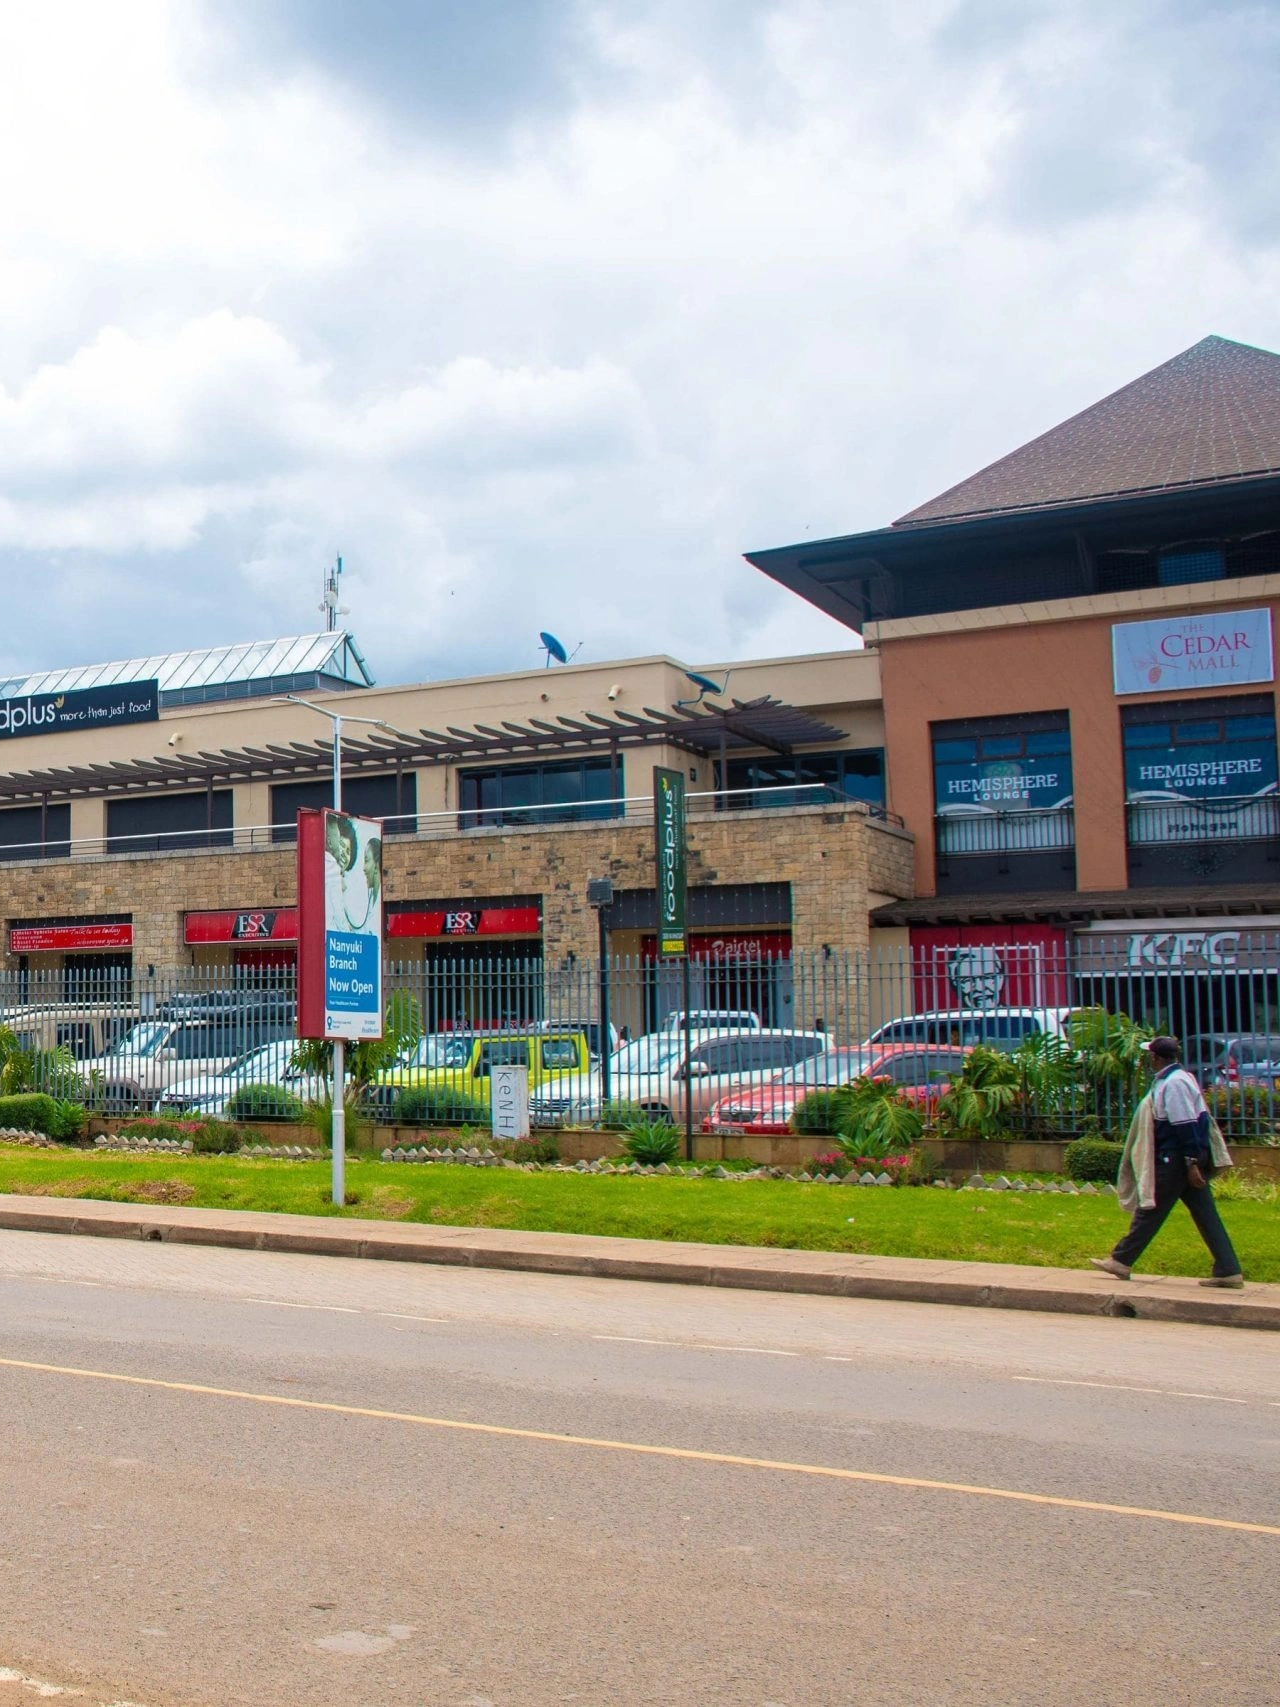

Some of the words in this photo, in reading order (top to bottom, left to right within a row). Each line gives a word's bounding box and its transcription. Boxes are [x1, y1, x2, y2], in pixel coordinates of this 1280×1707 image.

[1181, 624, 1204, 633] THE
[1160, 632, 1251, 657] CEDAR
[1188, 654, 1240, 672] MALL
[60, 711, 87, 721] more
[88, 706, 107, 719] than
[109, 702, 125, 718] just
[129, 700, 152, 713] food
[1139, 758, 1262, 780] HEMISPHERE
[947, 773, 1059, 794] HEMISPHERE
[1165, 776, 1227, 788] LOUNGE
[973, 790, 1030, 802] LOUNGE
[663, 789, 676, 922] foodplus
[238, 914, 269, 932] ESR
[446, 912, 475, 929] ESR
[329, 937, 363, 955] Nanyuki
[726, 938, 761, 953] airtel
[1123, 931, 1241, 967] KFC
[329, 955, 358, 971] Branch
[329, 977, 349, 993] Now
[351, 979, 373, 996] Open
